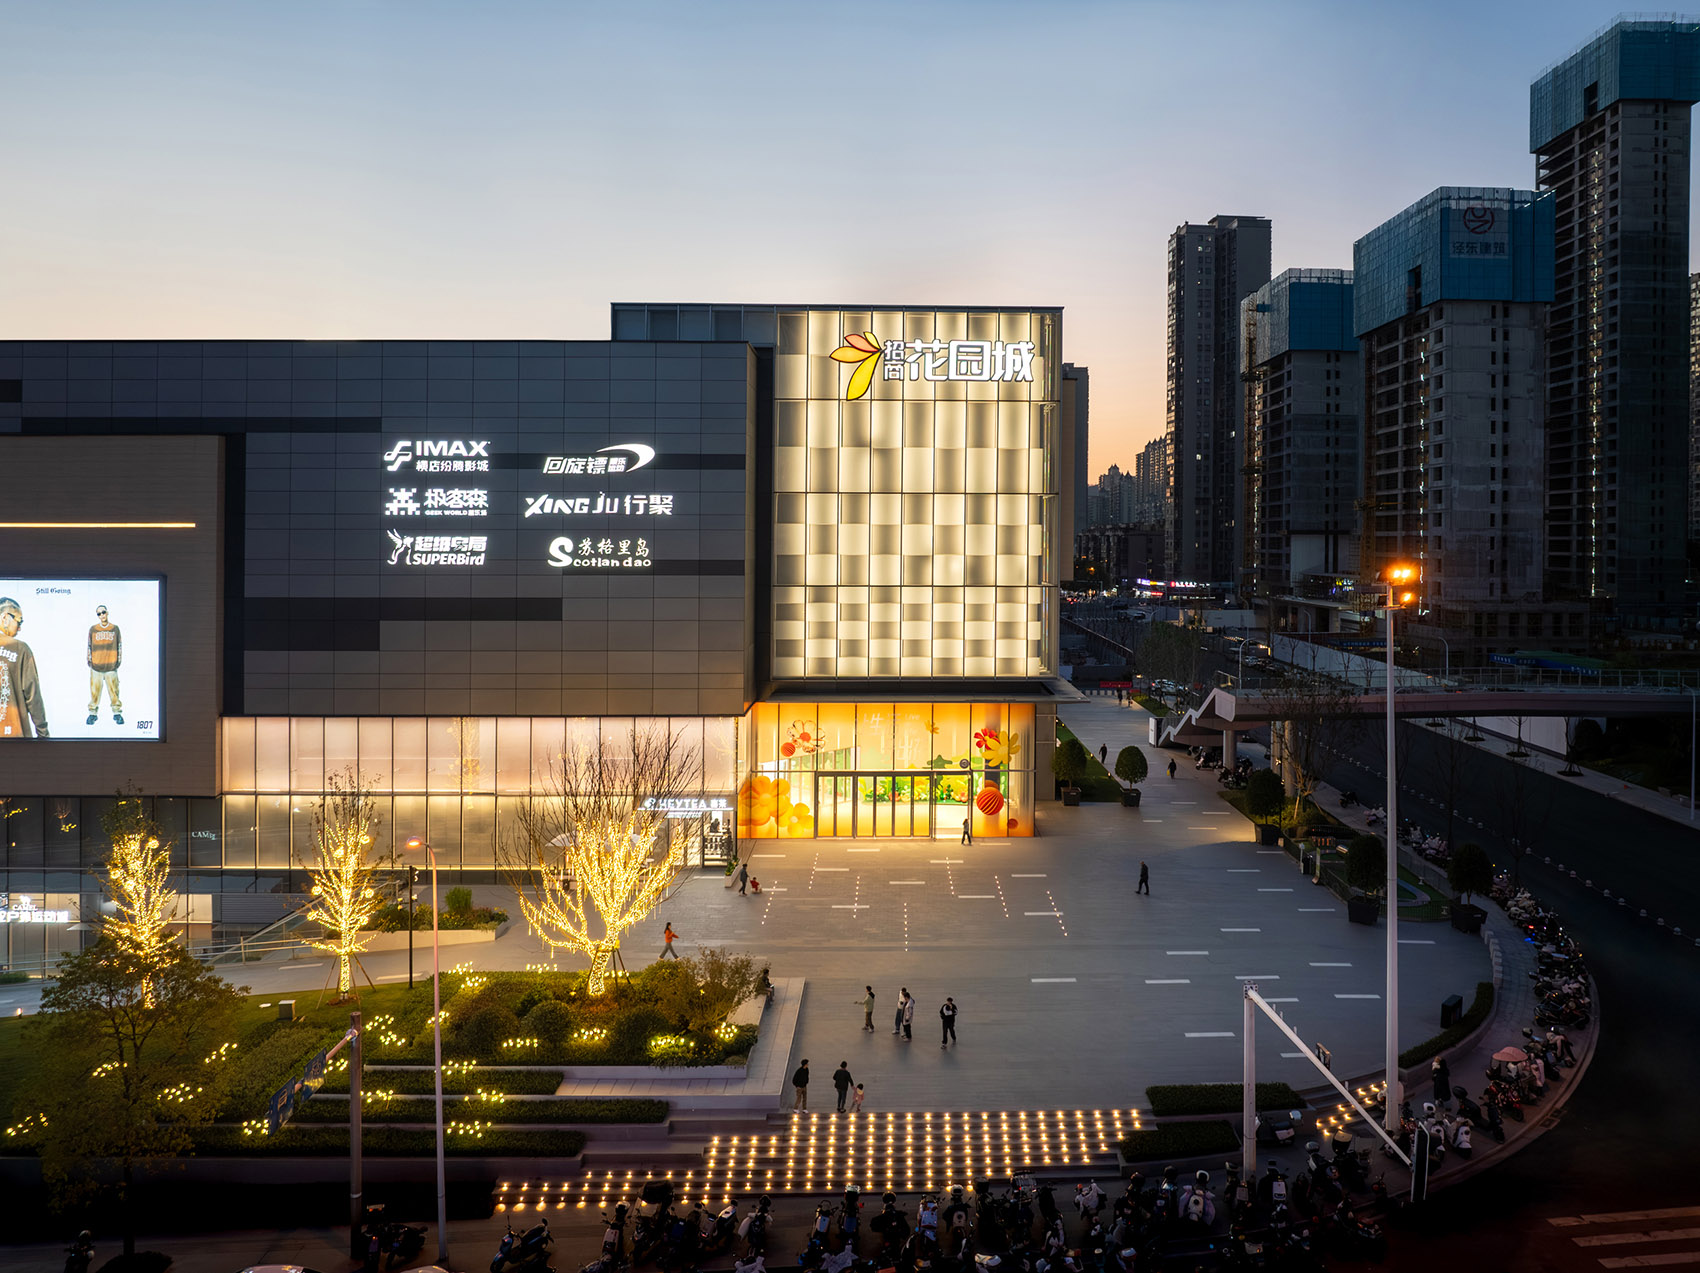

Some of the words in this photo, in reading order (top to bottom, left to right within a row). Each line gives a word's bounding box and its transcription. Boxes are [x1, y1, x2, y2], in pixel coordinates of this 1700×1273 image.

[883, 339, 905, 381] 招商
[905, 338, 1035, 381] 花园城
[416, 440, 488, 457] IMAX
[424, 488, 488, 508] 极客森
[524, 493, 590, 518] XING
[624, 495, 673, 516] 行聚
[578, 537, 649, 558] 苏格里岛
[412, 552, 485, 566] SUPERBird
[136, 720, 153, 730] 1807
